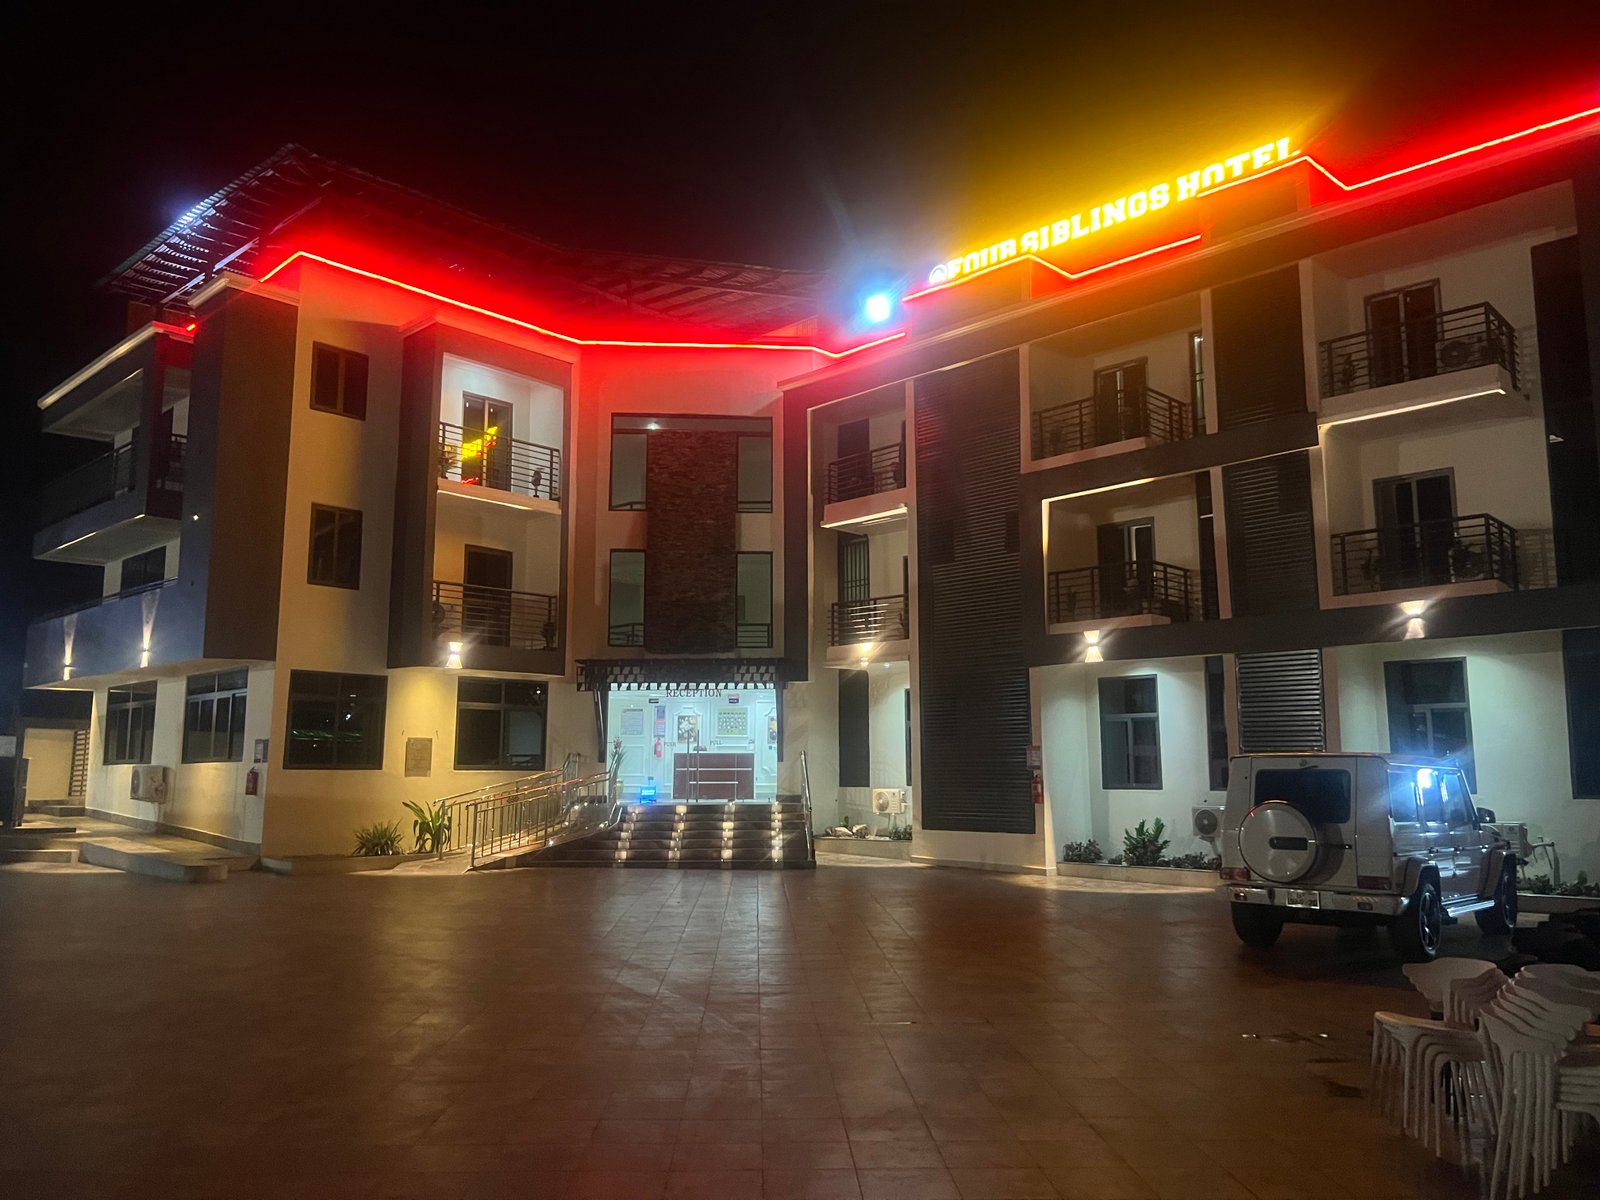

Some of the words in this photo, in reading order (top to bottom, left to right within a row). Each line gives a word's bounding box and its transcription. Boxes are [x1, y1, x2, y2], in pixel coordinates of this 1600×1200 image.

[946, 238, 1017, 280] FOUR
[1020, 182, 1171, 254] SIBLINGS
[1176, 136, 1301, 202] HOTEL
[666, 688, 722, 698] RECEPTION
